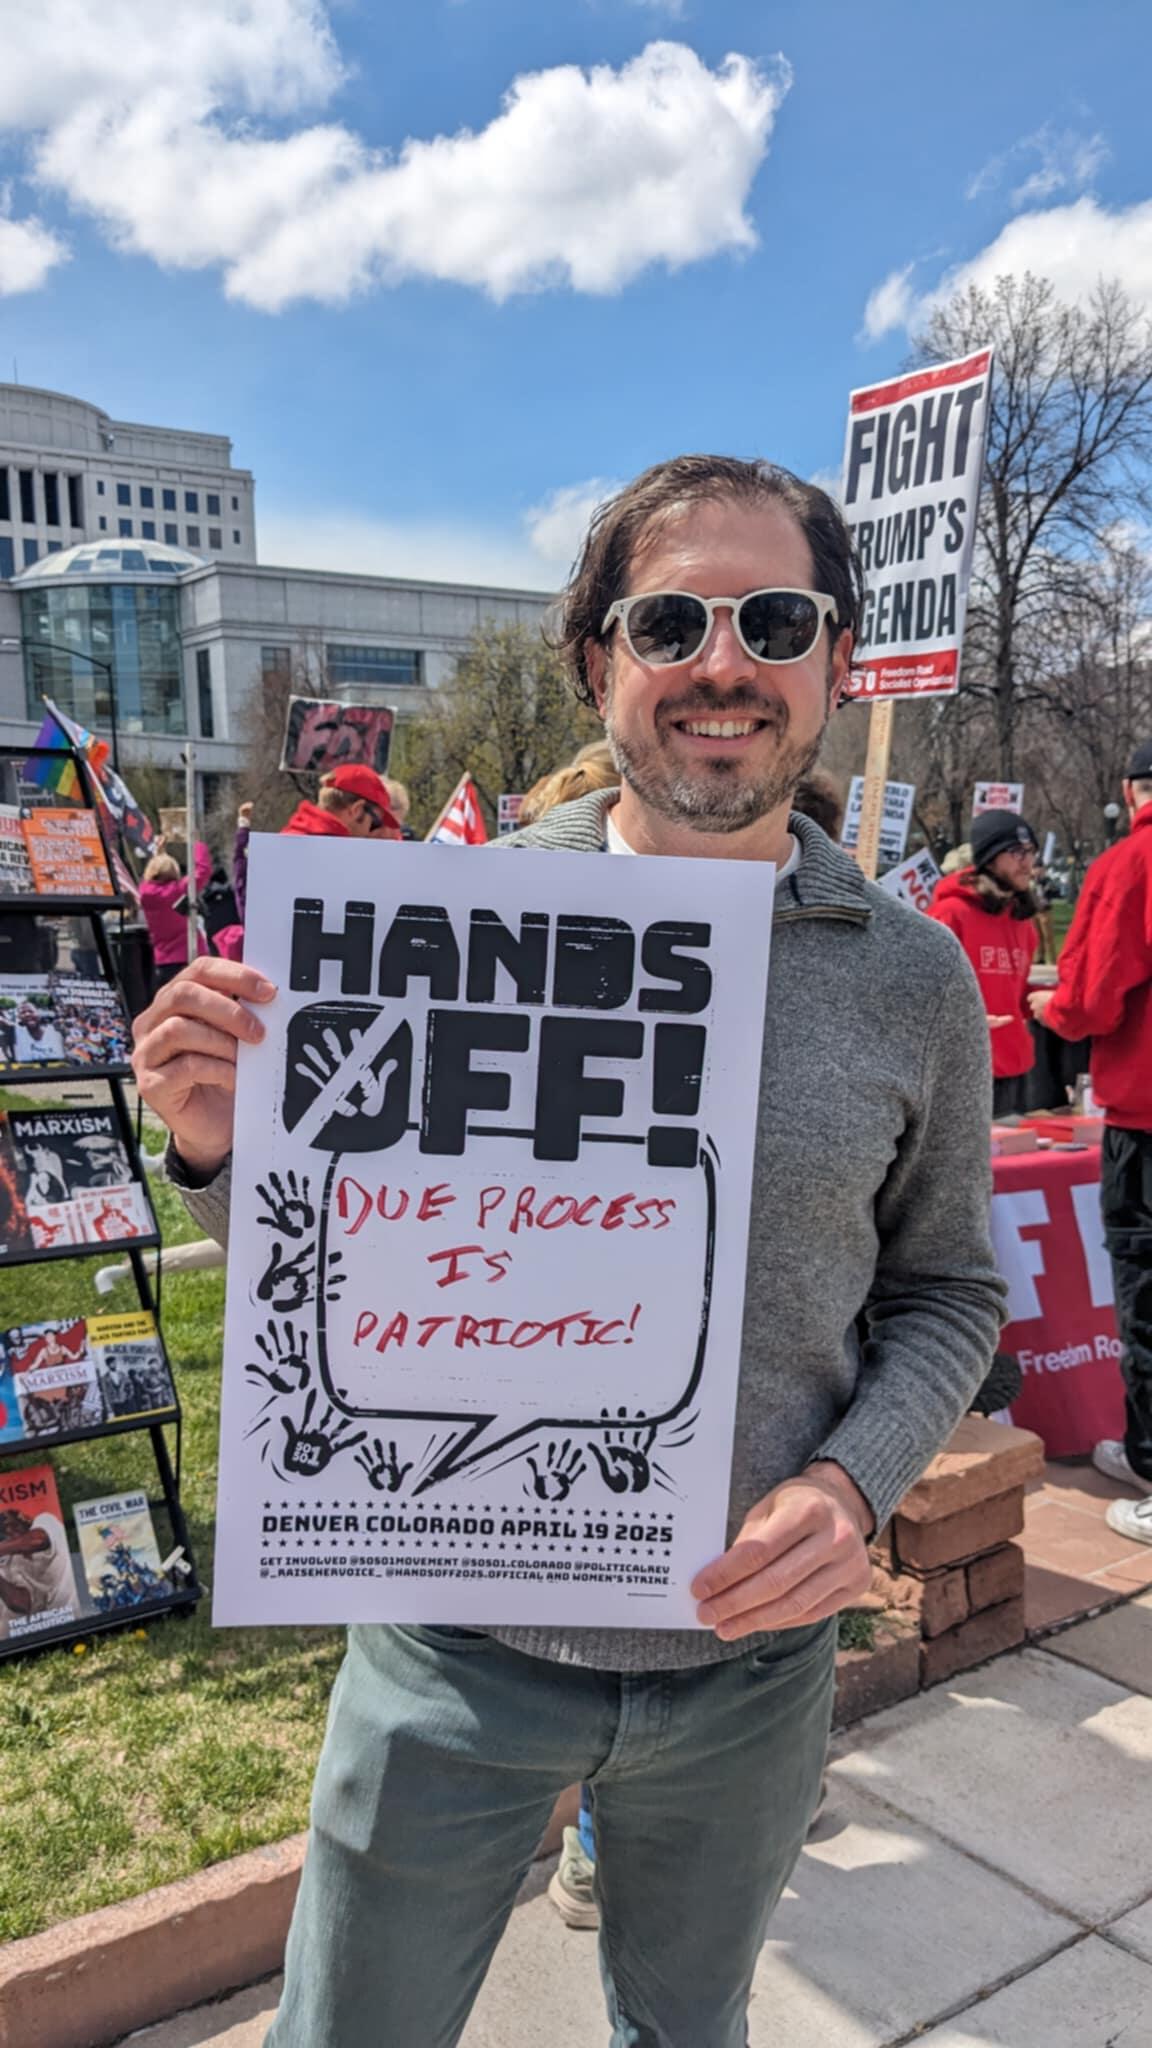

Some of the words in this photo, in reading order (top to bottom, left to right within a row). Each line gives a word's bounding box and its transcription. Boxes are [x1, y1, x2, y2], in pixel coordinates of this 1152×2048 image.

[845, 382, 984, 505] FIGHT
[848, 497, 966, 571] RUMP'S
[859, 574, 956, 648] GENDA
[289, 898, 713, 1014] HANDS
[282, 1000, 708, 1168] OFF!
[14, 1117, 112, 1136] MARXISM
[336, 1177, 456, 1235] DUE
[478, 1184, 677, 1234] PROCESS
[427, 1244, 512, 1288] IS
[353, 1303, 642, 1353] PATRIOTIC!
[27, 1369, 87, 1385] MARXISM
[79, 1507, 97, 1519] THE
[100, 1502, 122, 1514] CIVIL
[125, 1496, 144, 1508] WAR
[262, 1515, 360, 1533] DENVER
[365, 1515, 494, 1536] COLORADO
[501, 1519, 577, 1539] APRIL
[582, 1522, 609, 1540] 19
[614, 1523, 673, 1543] 2025
[260, 1557, 282, 1566] GET
[285, 1556, 347, 1566] INVOLVED
[574, 1561, 670, 1574] @POLITICALREV
[385, 1568, 544, 1581] @HANDSOFF2025.OFFICIAL
[546, 1572, 570, 1581] AND
[572, 1573, 624, 1584] WOMEN'S
[626, 1575, 669, 1585] STRIKE
[8, 1615, 28, 1629] THE
[30, 1605, 73, 1622] AFRICAN
[9, 1615, 75, 1638] REVOLUTION
